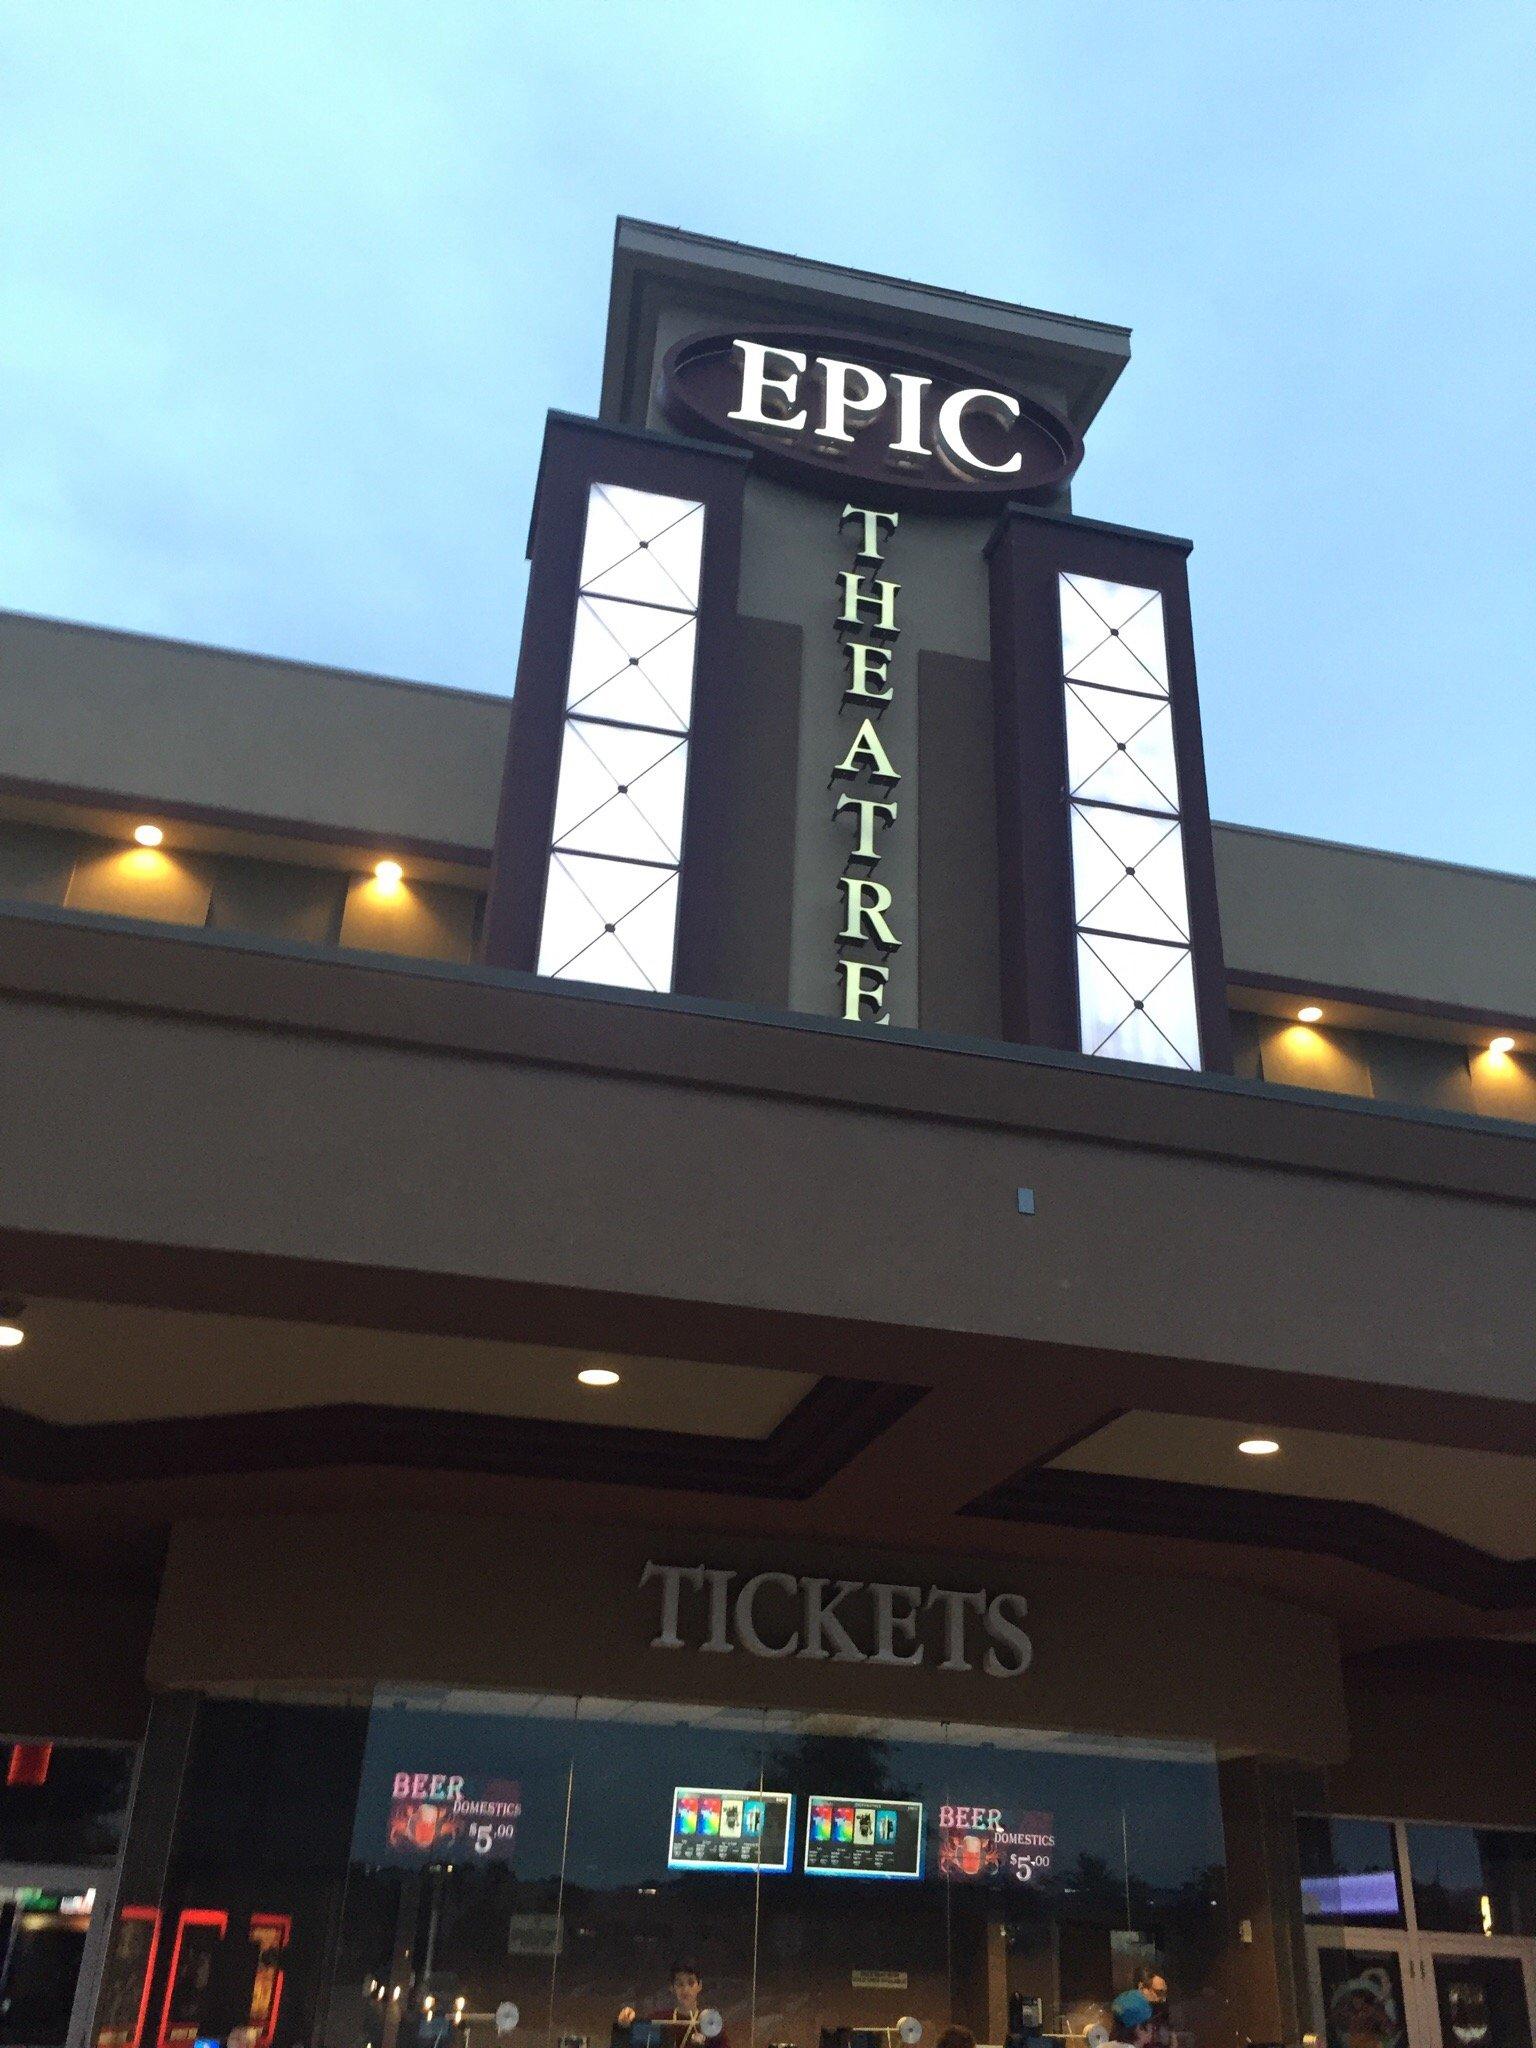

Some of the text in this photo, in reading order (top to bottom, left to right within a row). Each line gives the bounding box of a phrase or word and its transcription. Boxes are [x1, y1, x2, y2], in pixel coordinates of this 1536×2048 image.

[727, 339, 1023, 474] EPIC
[835, 503, 902, 1027] THEATRE
[637, 1560, 1033, 1678] TICKETS
[392, 1772, 465, 1801] BEER
[452, 1800, 522, 1817] DOMESTICS
[939, 1805, 1004, 1832] BEER
[994, 1833, 1055, 1847] DOMESTICS
